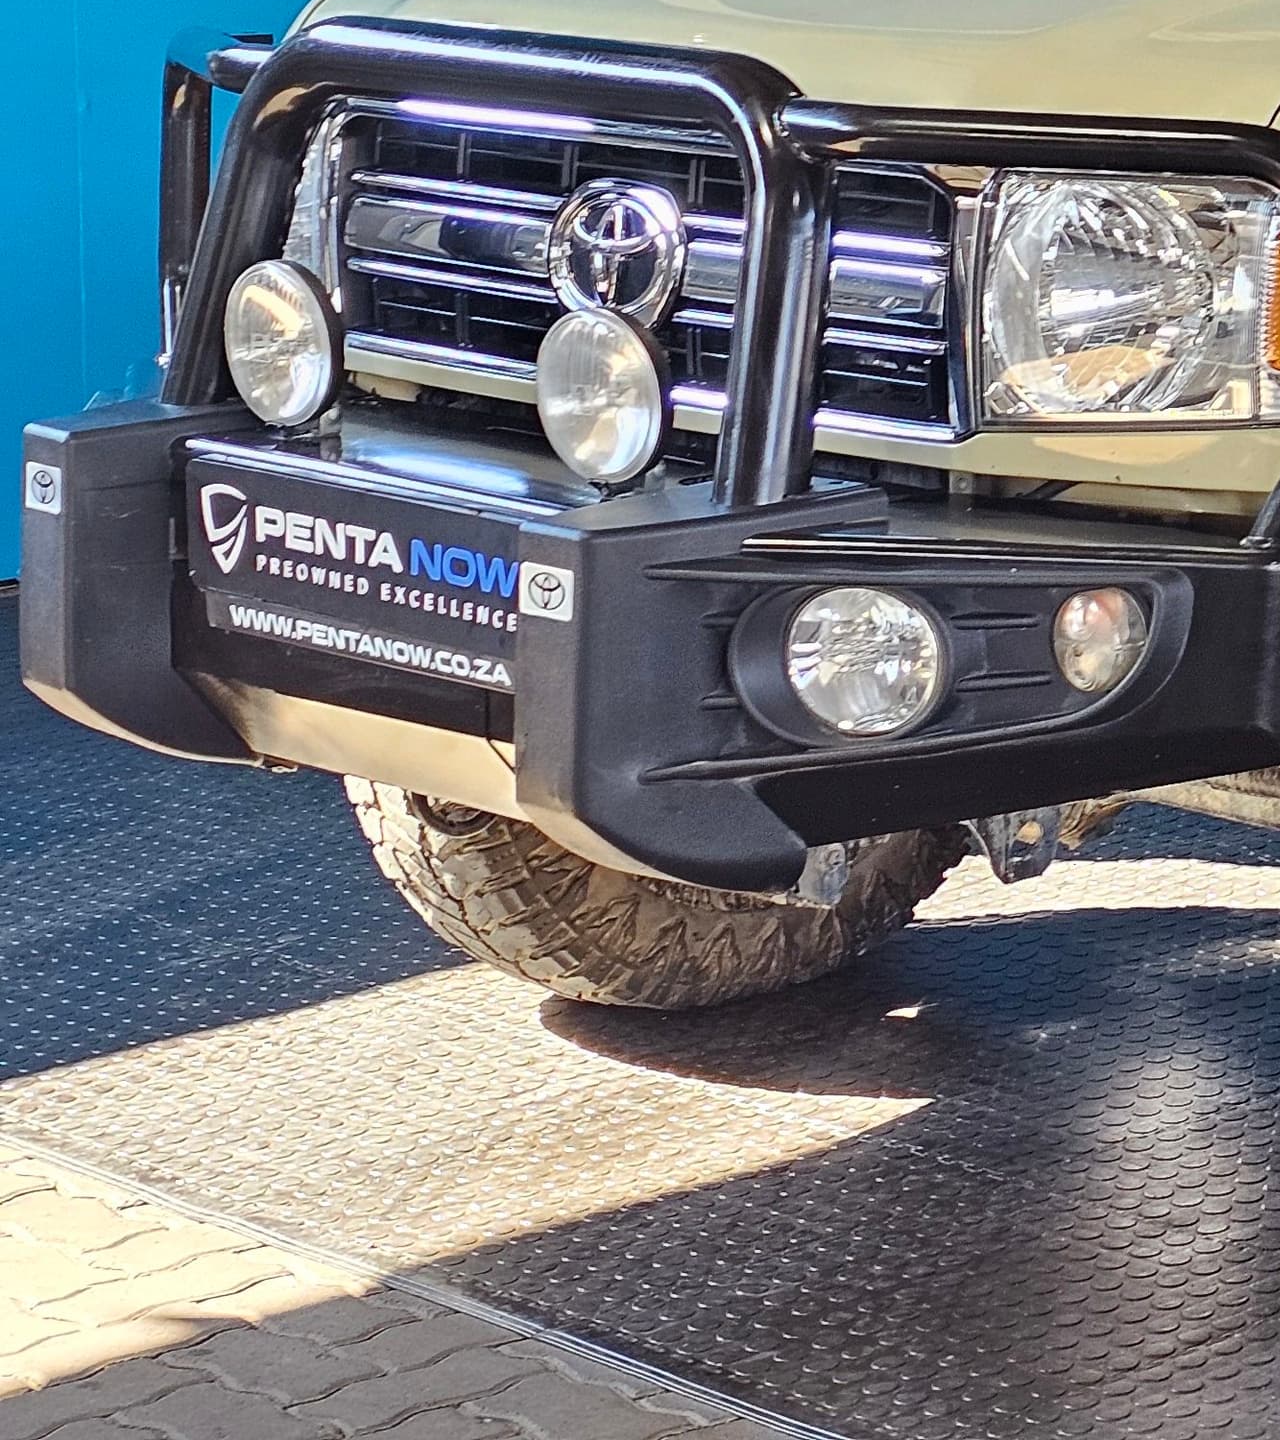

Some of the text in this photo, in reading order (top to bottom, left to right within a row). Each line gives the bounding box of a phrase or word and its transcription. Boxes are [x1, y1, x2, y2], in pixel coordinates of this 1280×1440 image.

[255, 505, 519, 598] PENTA NOW
[256, 554, 518, 633] PREOWNED EXCELLENCE
[229, 604, 513, 687] WWW.PENTANOW.CO.ZA
